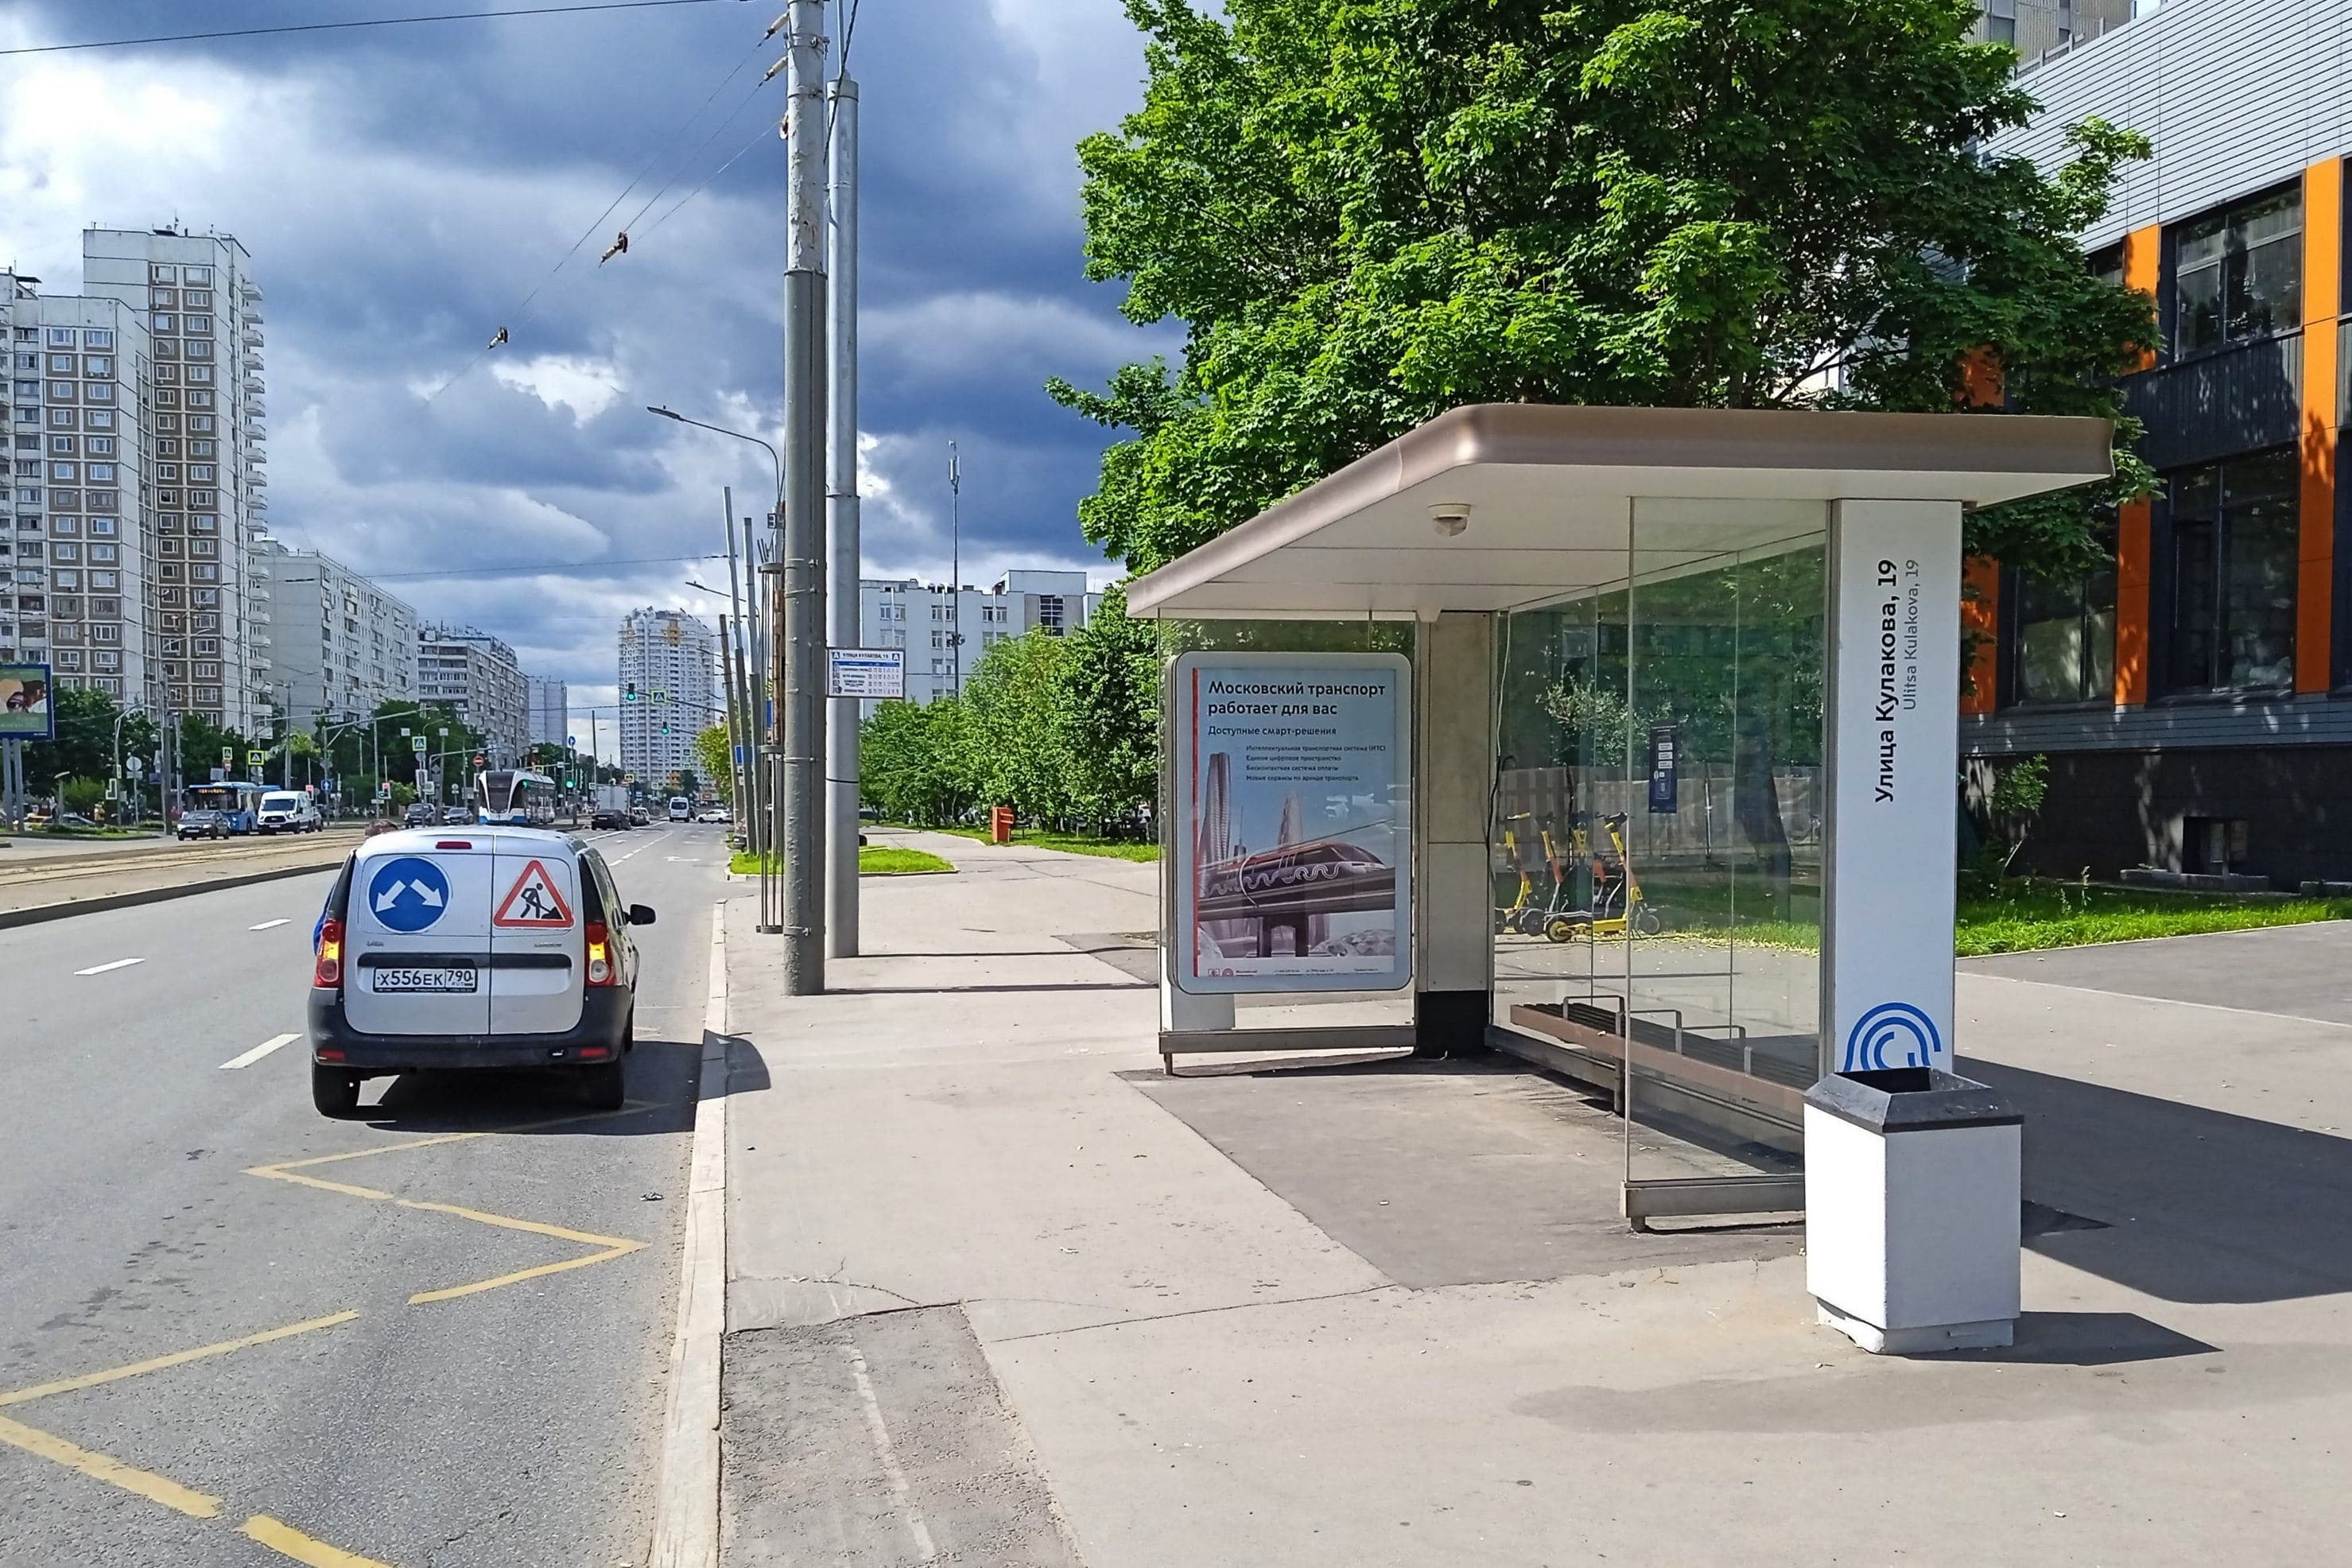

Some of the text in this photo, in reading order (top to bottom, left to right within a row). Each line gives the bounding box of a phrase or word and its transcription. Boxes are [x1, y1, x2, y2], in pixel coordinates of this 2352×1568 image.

[1903, 559, 1919, 710] Ulitsa Kulakova, 19
[1875, 559, 1900, 803] Улица Кулакова, 19
[1209, 681, 1386, 698] Московский транспорт
[1209, 701, 1337, 716] работает для вас
[1208, 725, 1337, 737] Доступные смарт-решения
[447, 970, 472, 982] 790
